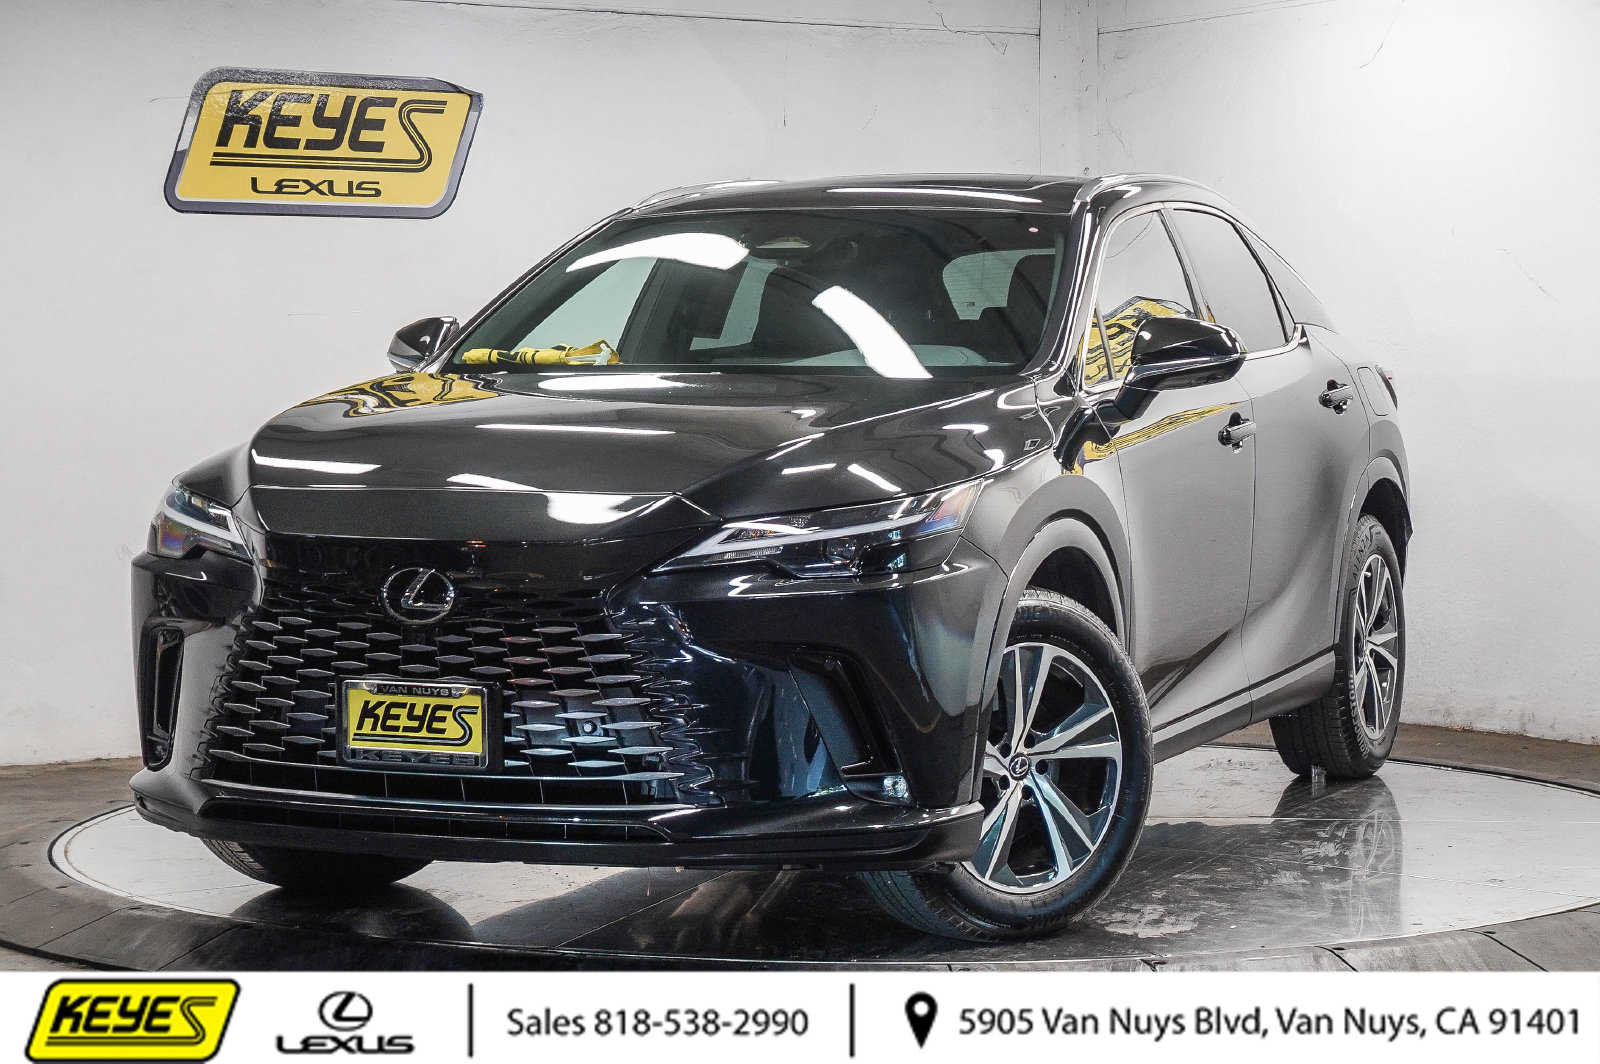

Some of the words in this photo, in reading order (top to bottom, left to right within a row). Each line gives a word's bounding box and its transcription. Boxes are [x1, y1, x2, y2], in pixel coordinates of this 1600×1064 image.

[209, 88, 448, 173] KEYES
[250, 176, 382, 198] LEXUS
[380, 684, 408, 695] VAN
[412, 687, 450, 697] NUYS
[351, 699, 480, 747] KEYES
